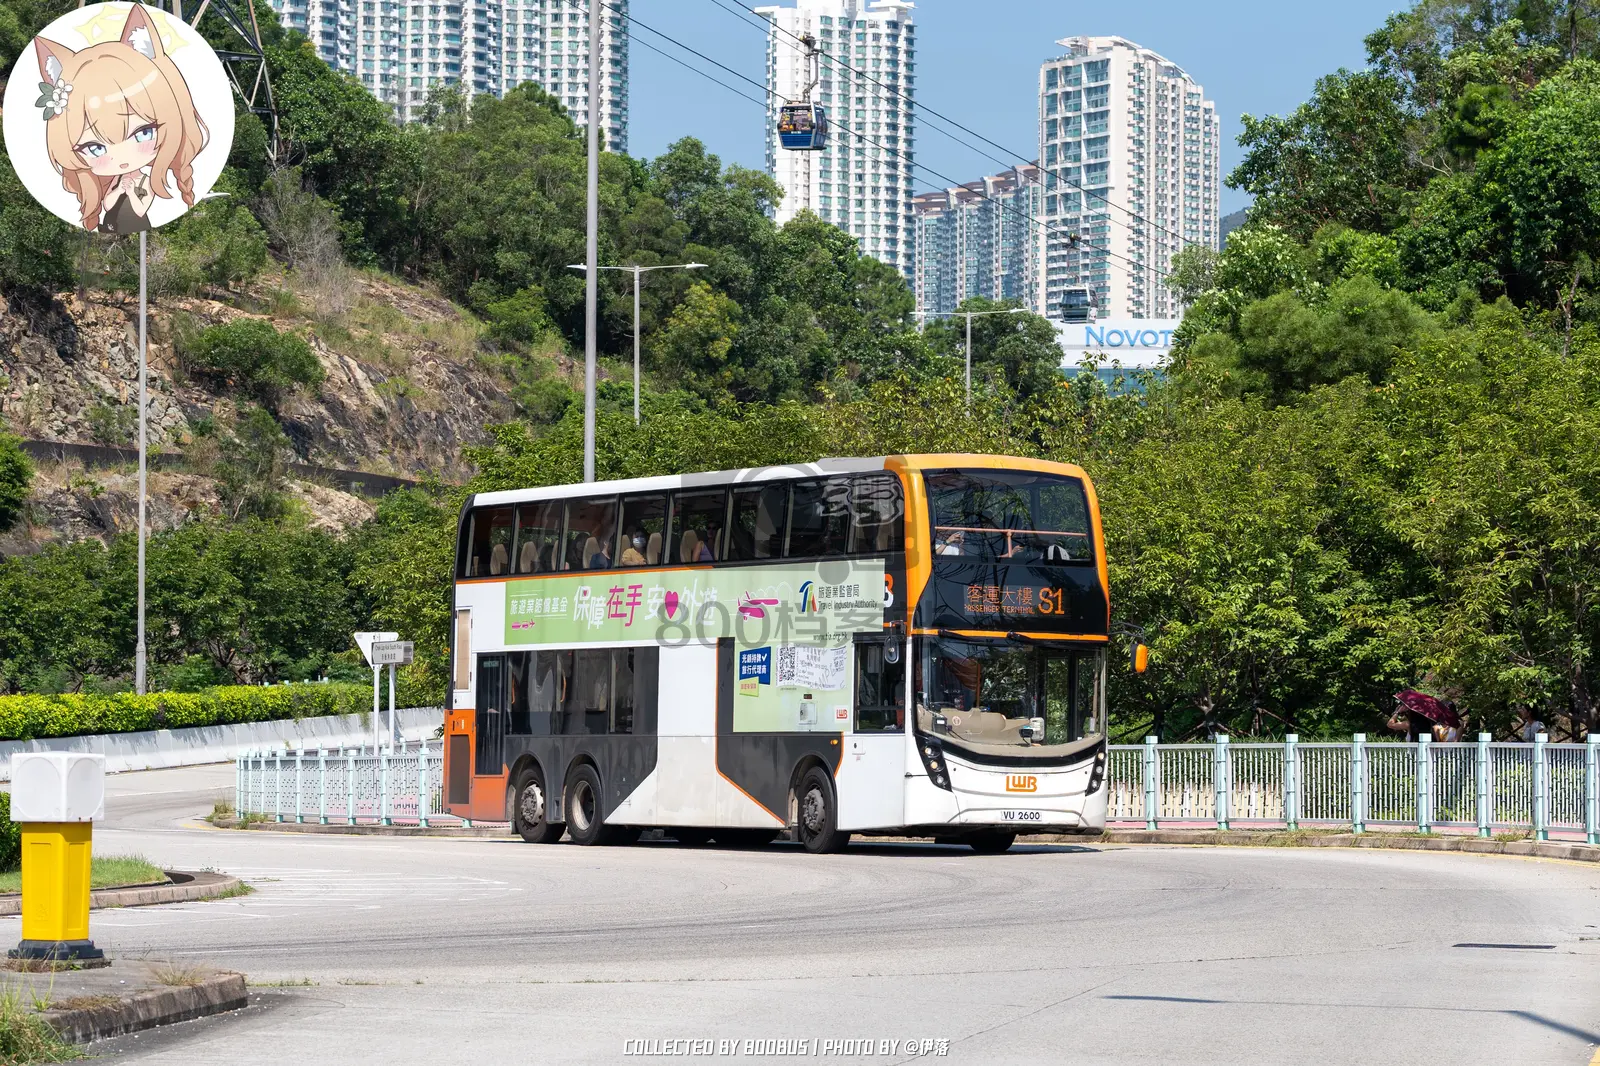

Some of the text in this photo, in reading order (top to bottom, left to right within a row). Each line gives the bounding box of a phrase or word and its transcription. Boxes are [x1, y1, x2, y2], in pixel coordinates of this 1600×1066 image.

[1085, 326, 1175, 347] NOVOT
[967, 584, 1033, 605] 客運大樓
[1038, 587, 1065, 615] S1
[510, 596, 568, 615] 旅遊業賠償基金
[818, 598, 878, 611] Travel Industry Authority
[964, 604, 1035, 615] PASSENGER TERMINAL
[1006, 775, 1038, 792] LWB
[1003, 811, 1041, 820] VU 2600
